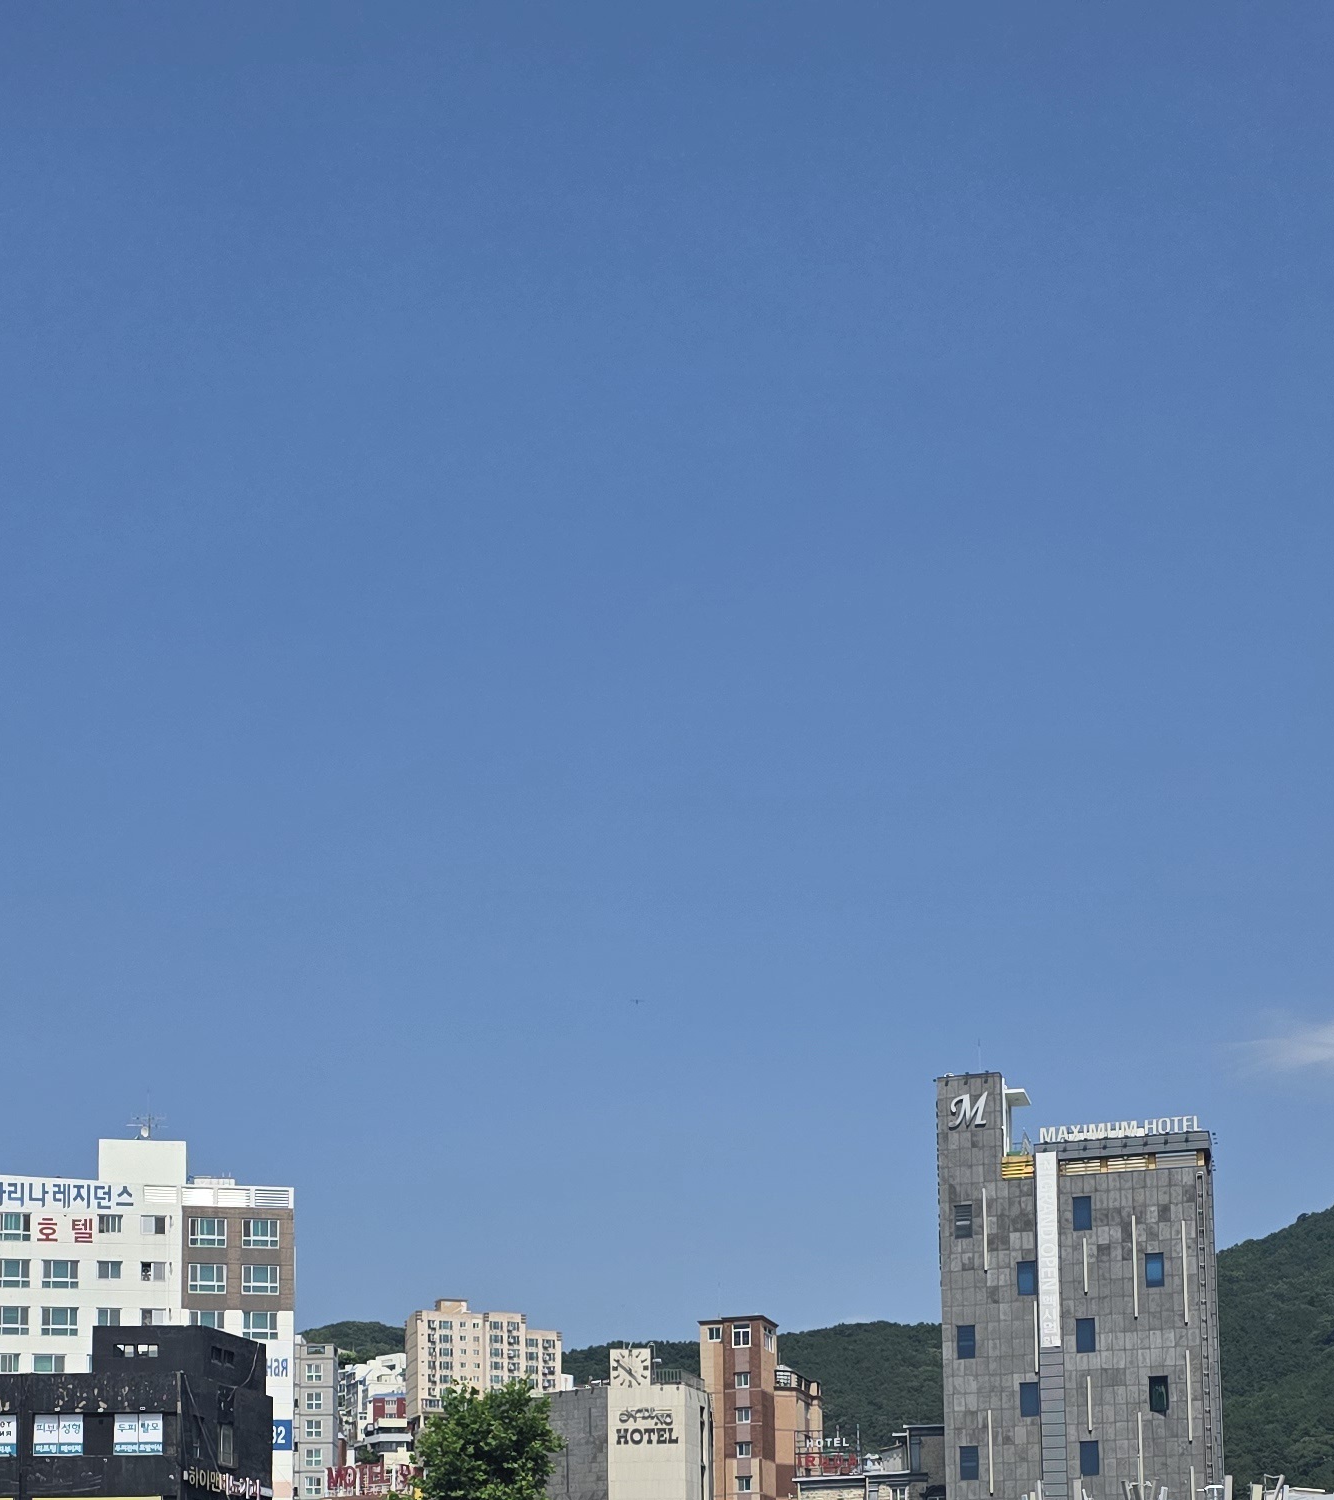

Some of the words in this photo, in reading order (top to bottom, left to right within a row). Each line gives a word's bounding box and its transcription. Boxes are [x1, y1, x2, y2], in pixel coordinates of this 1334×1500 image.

[1039, 1120, 1137, 1144] MAXIMUM
[1143, 1116, 1201, 1136] HOTEL
[36, 1217, 93, 1244] 호텔
[615, 1428, 679, 1446] HOTEL
[805, 1437, 849, 1448] HOTEL
[327, 1464, 391, 1491] MOTEL
